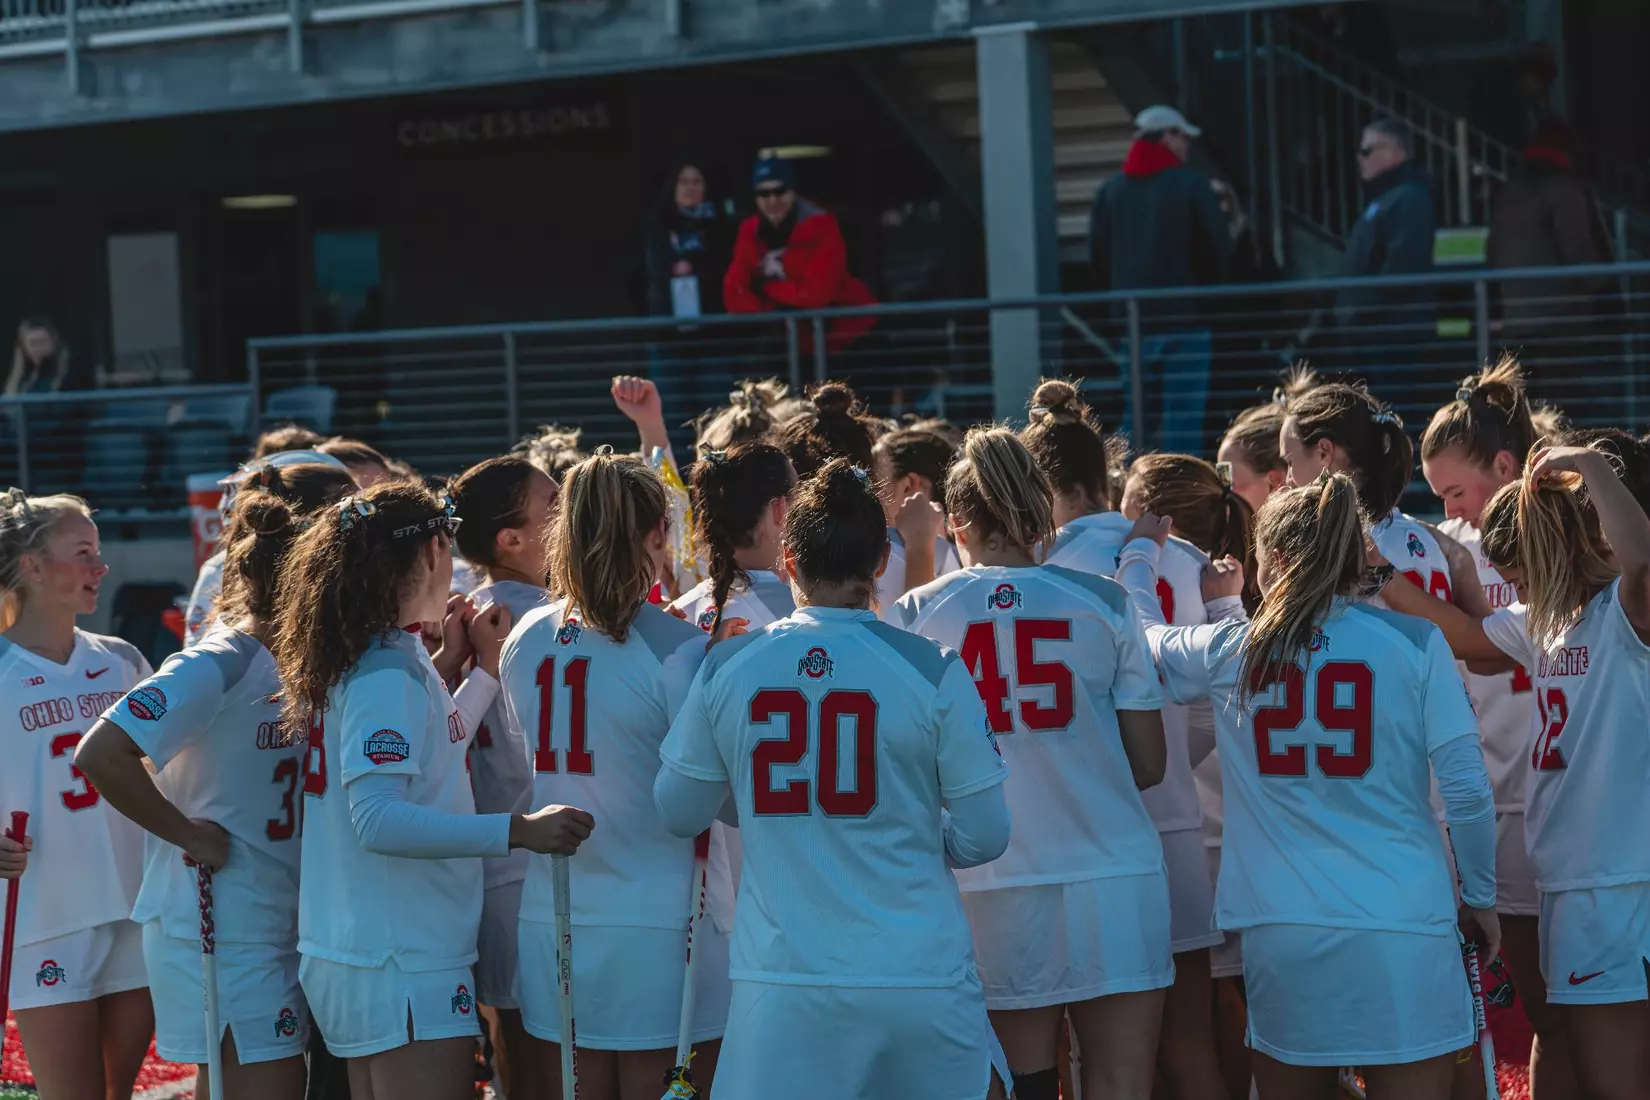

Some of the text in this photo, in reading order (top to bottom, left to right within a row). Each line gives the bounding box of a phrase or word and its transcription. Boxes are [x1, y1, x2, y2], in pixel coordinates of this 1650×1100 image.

[397, 102, 611, 146] CONCESSIONS
[393, 524, 421, 538] STX
[128, 690, 165, 720] LACROSSE
[960, 617, 1076, 734] 45
[20, 697, 74, 731] OHIO
[535, 654, 595, 776] 11
[1249, 659, 1375, 779] 29
[50, 729, 101, 812] 3
[365, 741, 409, 757] LACROSSE
[748, 687, 879, 819] 20
